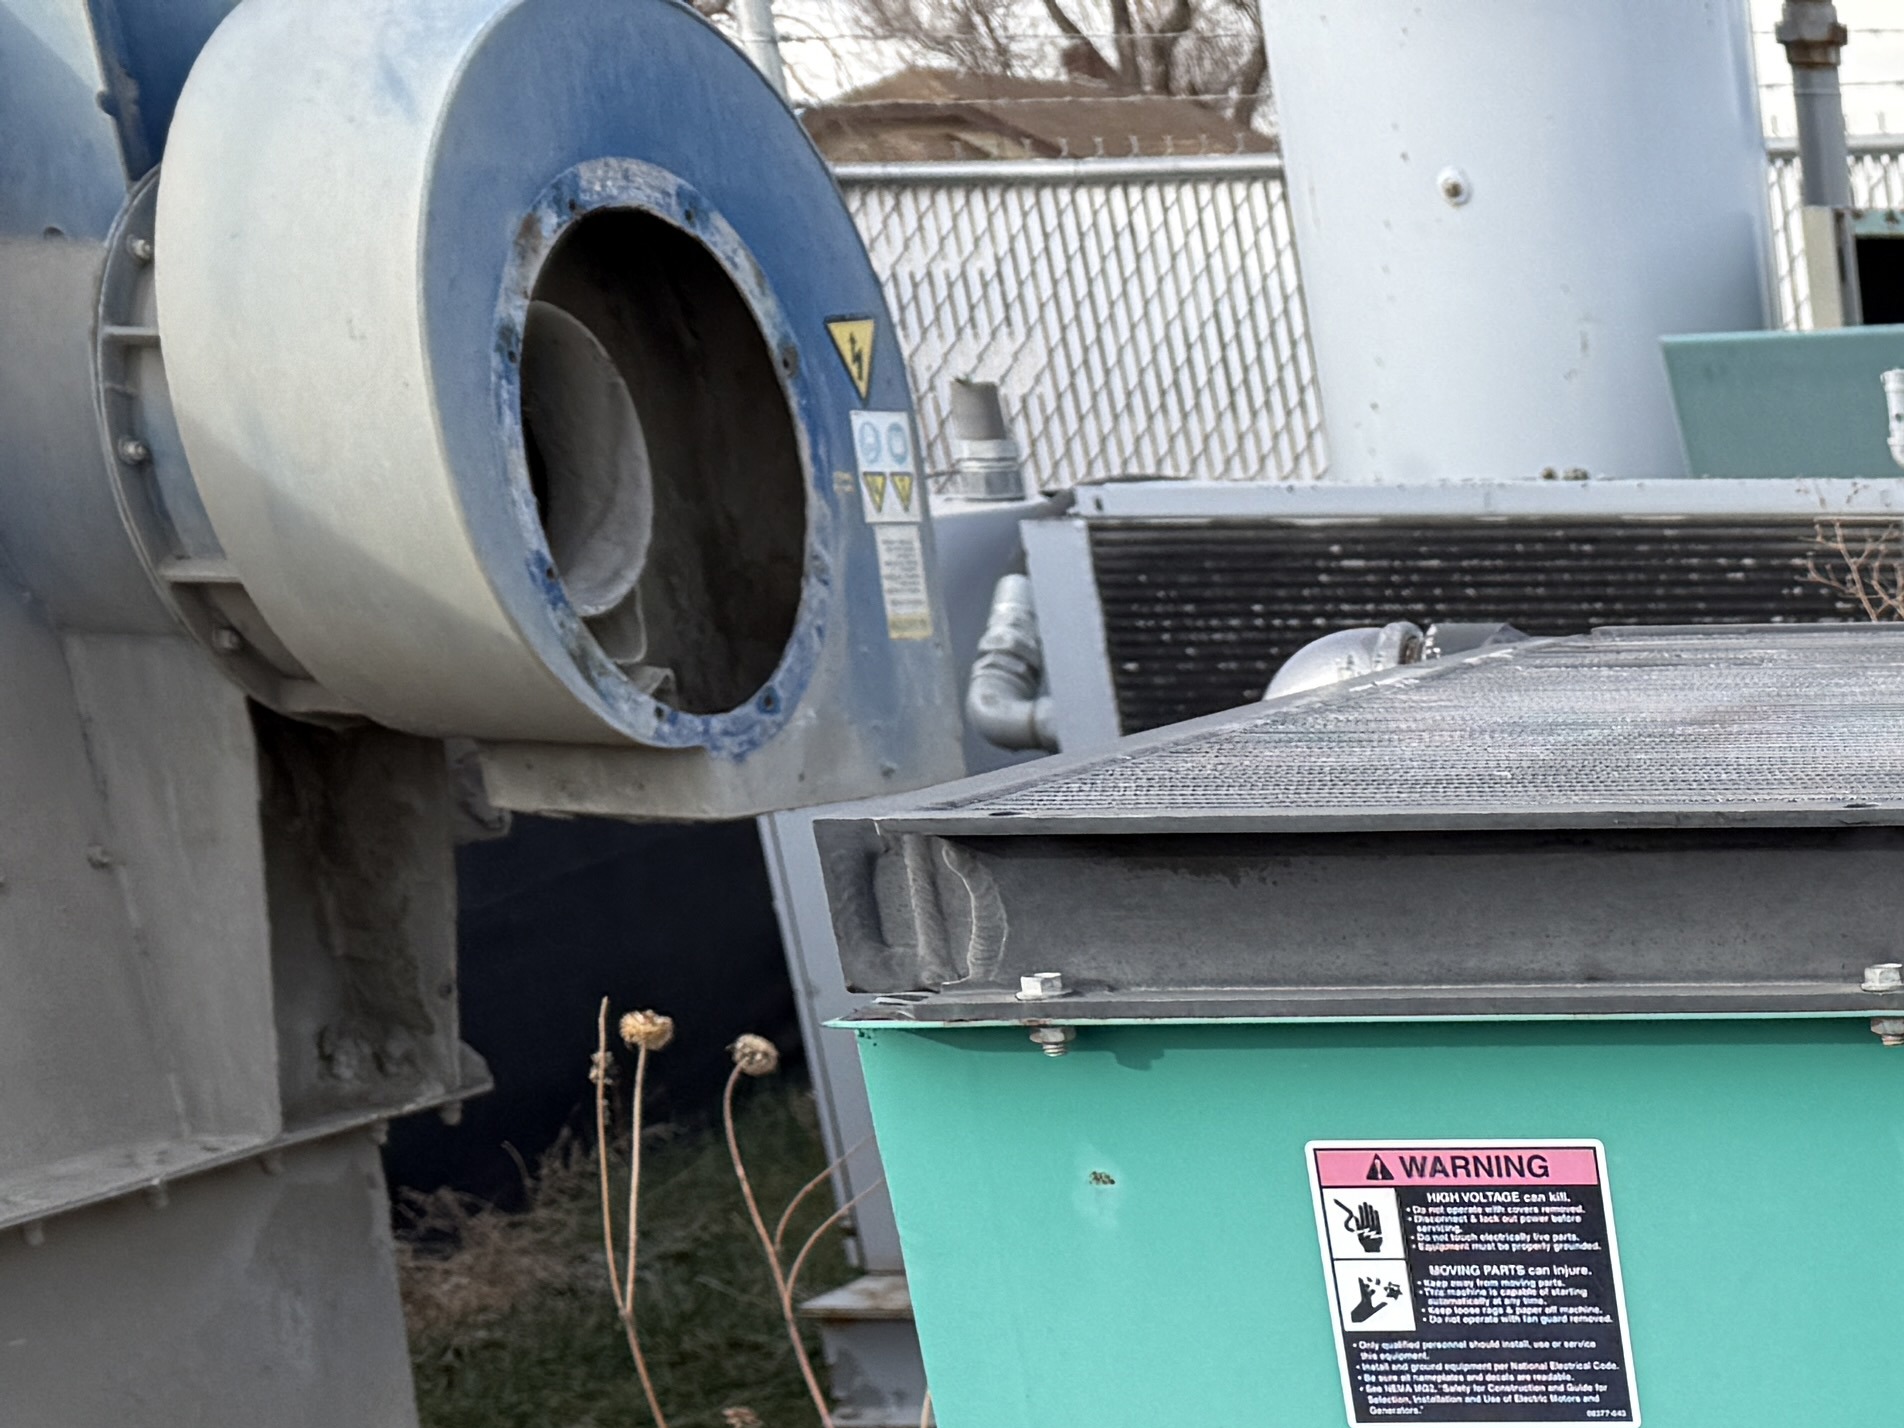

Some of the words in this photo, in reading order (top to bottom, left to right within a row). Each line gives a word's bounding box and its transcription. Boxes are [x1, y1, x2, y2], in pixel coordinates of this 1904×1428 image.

[1398, 1155, 1550, 1178] WARNING
[1427, 1192, 1459, 1202] HIGH
[1461, 1192, 1519, 1202] VOLTAGE
[1524, 1194, 1545, 1202] can
[1549, 1192, 1571, 1202] kill.
[1429, 1265, 1480, 1276] MOVING
[1484, 1265, 1524, 1275] PARTS
[1528, 1267, 1550, 1275] can
